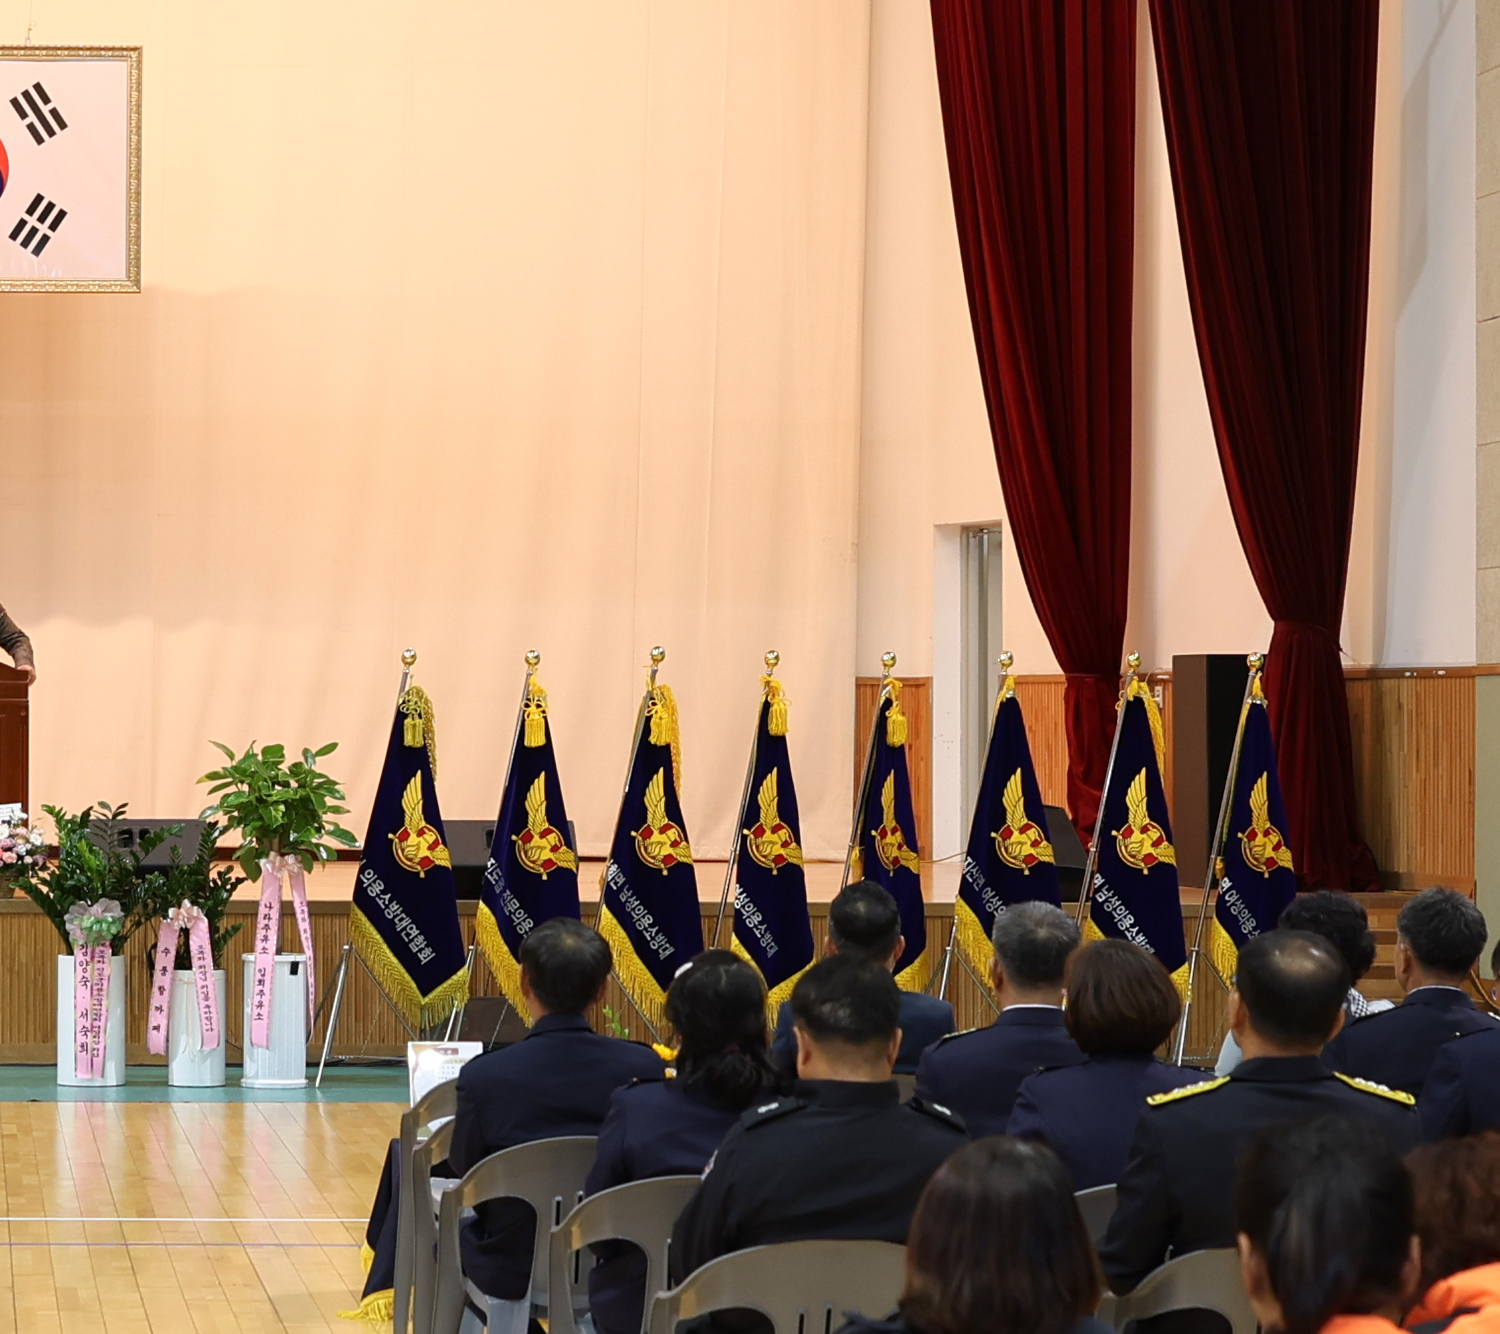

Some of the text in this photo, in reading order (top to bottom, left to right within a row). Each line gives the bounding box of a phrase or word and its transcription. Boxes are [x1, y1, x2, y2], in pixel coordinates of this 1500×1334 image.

[258, 901, 274, 955] 나라주유소
[360, 868, 436, 965] 의용소방대연합회
[500, 889, 534, 942] 전문의용
[618, 884, 675, 960] 남성의용소방대
